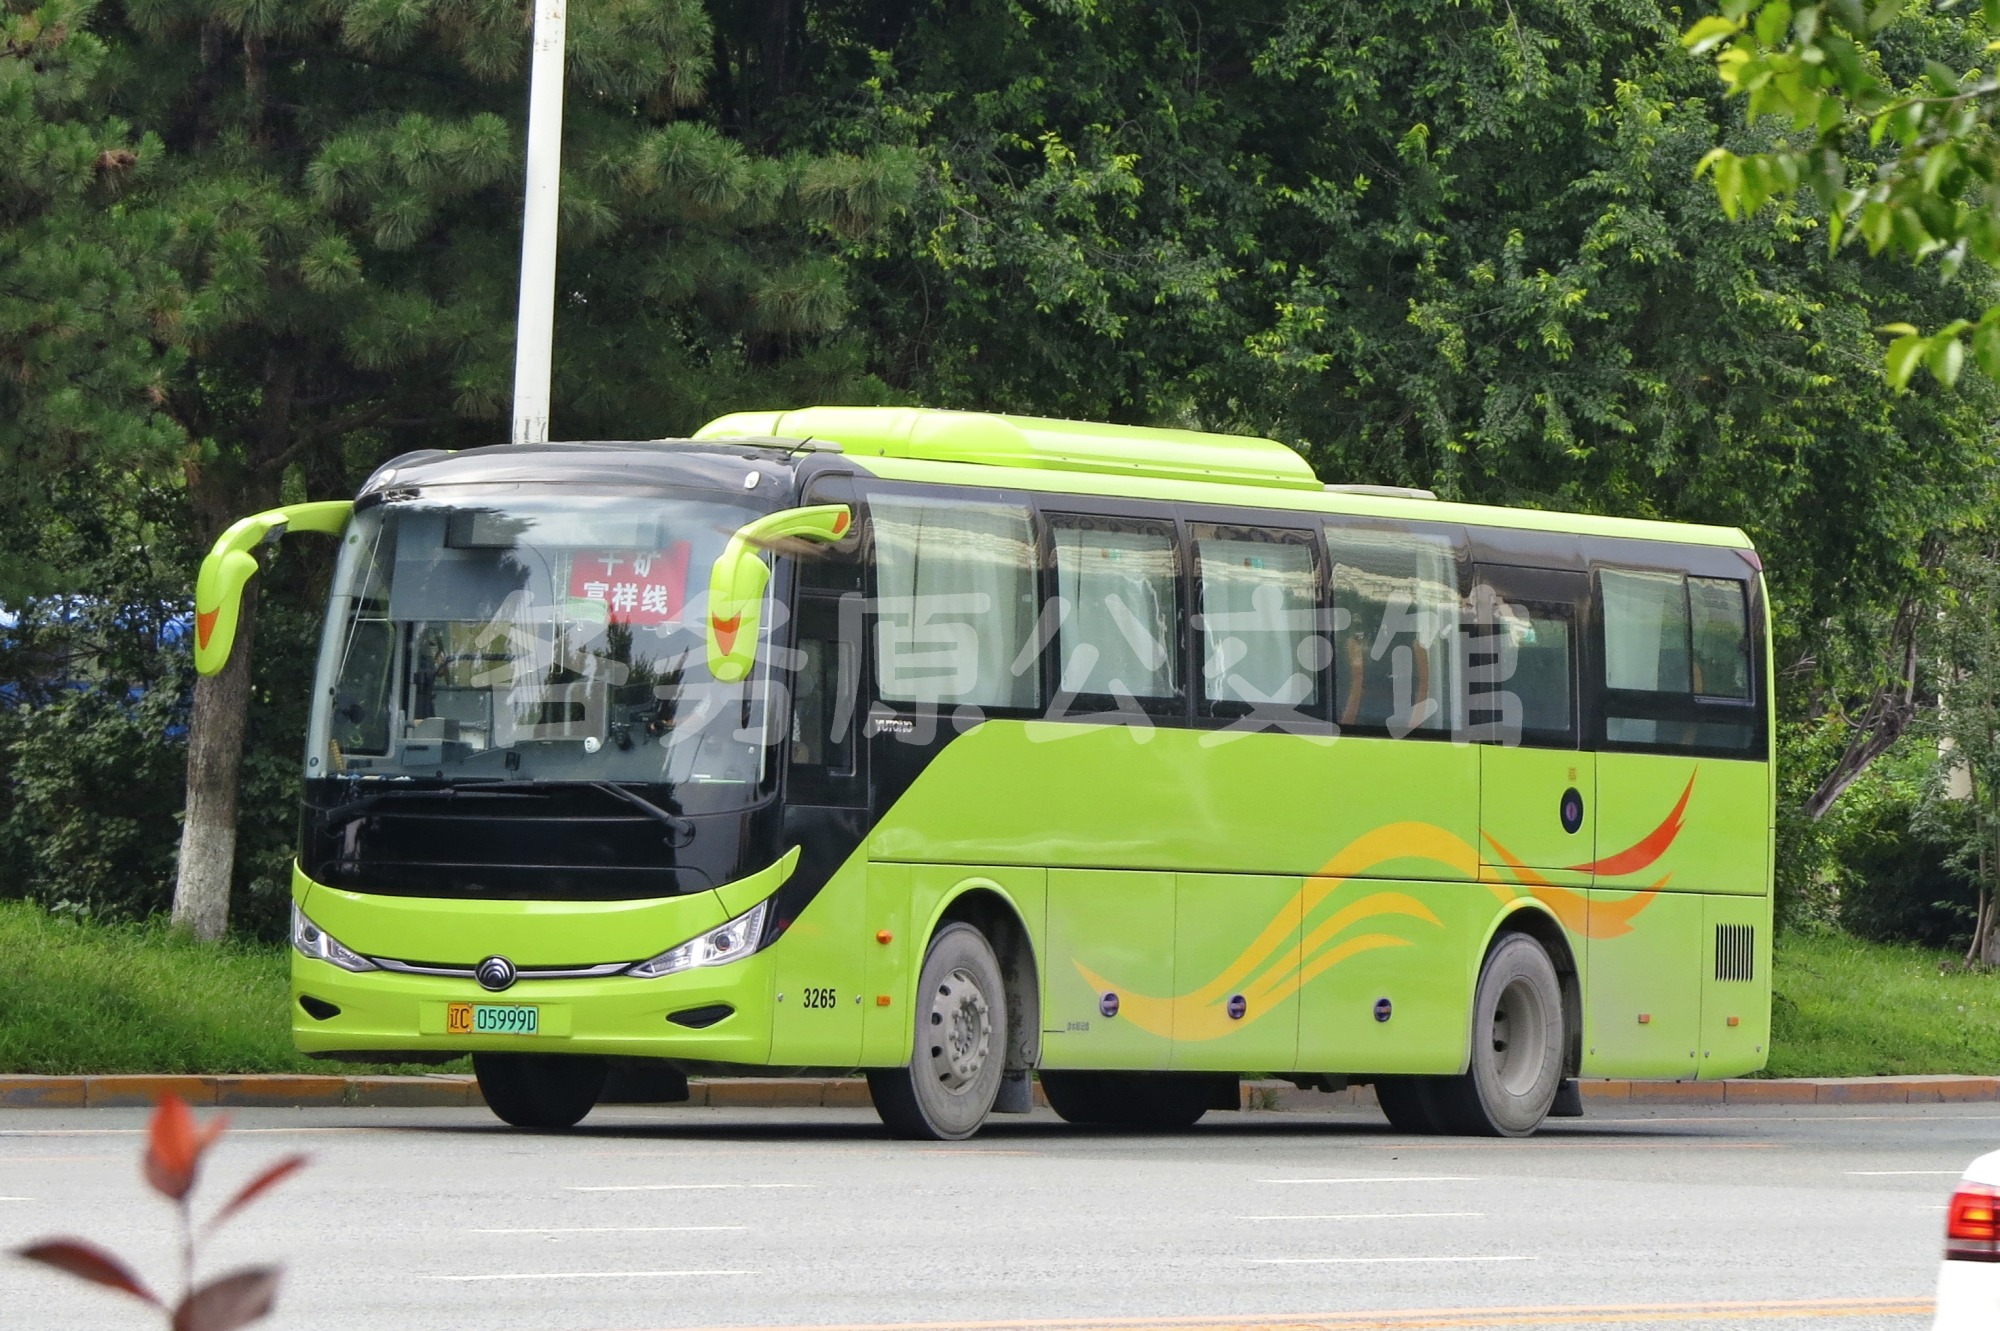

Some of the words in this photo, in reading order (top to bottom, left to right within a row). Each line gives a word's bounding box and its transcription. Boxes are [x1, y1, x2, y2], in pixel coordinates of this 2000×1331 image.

[584, 581, 668, 614] 富祥线
[804, 988, 836, 1008] 3265
